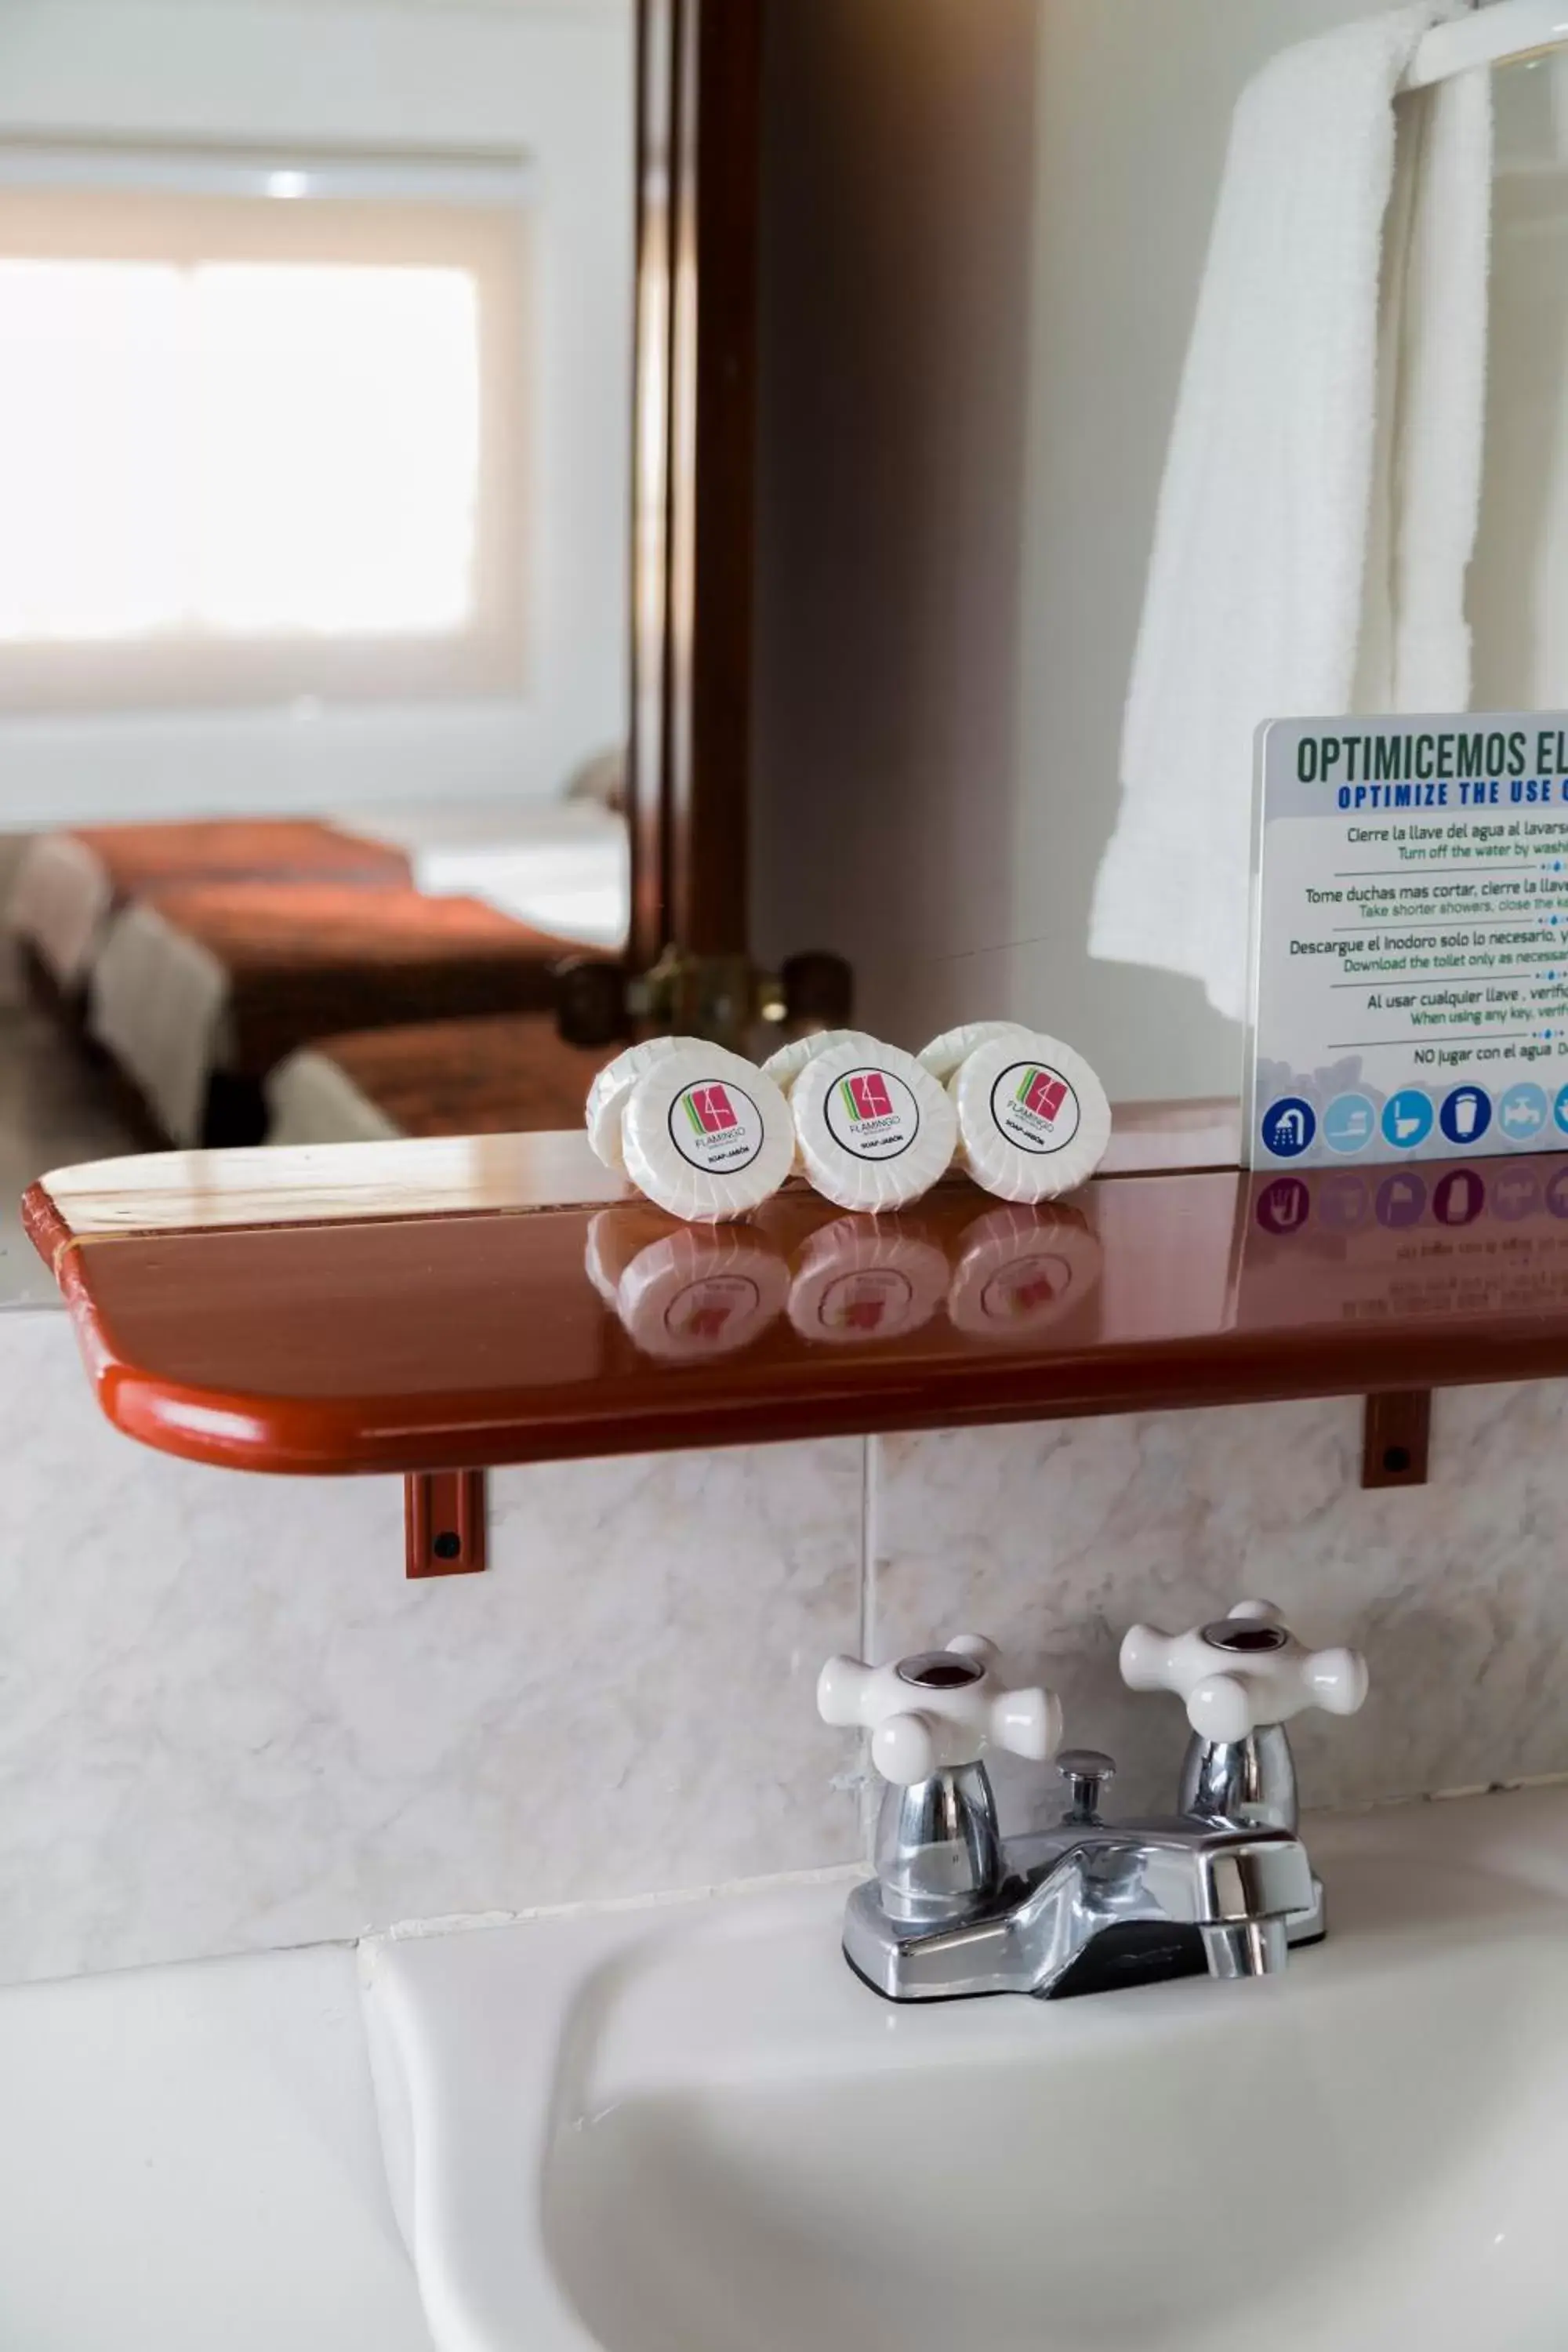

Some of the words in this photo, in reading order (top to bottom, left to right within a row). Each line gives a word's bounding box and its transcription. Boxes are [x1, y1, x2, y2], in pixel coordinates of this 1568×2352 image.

[1297, 731, 1526, 783] OPTIMICEMOS
[1536, 731, 1568, 776] EL
[1338, 783, 1448, 810] OPTIMIZE
[1460, 782, 1499, 804] THE
[1510, 779, 1551, 803] USE
[1347, 826, 1389, 843] Cierre
[1392, 825, 1406, 840] la
[1409, 824, 1443, 840] llave
[1447, 822, 1468, 838] del
[1472, 825, 1504, 842] agua
[1508, 820, 1520, 837] al
[1524, 821, 1568, 836] lavars
[1398, 846, 1426, 861] Turn
[1428, 844, 1448, 858] off
[1451, 844, 1472, 858] the
[1475, 844, 1512, 857] water
[1514, 843, 1529, 858] by
[1305, 887, 1342, 904] Tome
[1346, 885, 1396, 902] duchas
[1399, 887, 1429, 900] mas
[1481, 880, 1521, 895] cierre
[1524, 877, 1537, 893] la
[1359, 905, 1388, 918] Take
[1392, 902, 1436, 916] shorter
[1497, 898, 1531, 911] close
[1534, 898, 1554, 909] the
[1290, 938, 1364, 956] Descargue
[1367, 936, 1381, 951] el
[1384, 935, 1437, 950] inodoro
[1440, 931, 1468, 947] solo
[1472, 931, 1486, 946] lo
[1344, 957, 1406, 973] Download
[1410, 956, 1429, 970] the
[1432, 953, 1465, 968] toilet
[1468, 952, 1496, 967] only
[1498, 953, 1513, 964] as
[1367, 994, 1382, 1010] Al
[1385, 994, 1417, 1008] usar
[1420, 989, 1483, 1009] cualquier
[1411, 1011, 1446, 1025] When
[1449, 1009, 1482, 1025] using
[1485, 1010, 1508, 1025] any
[1414, 1048, 1436, 1063] NO
[1438, 1046, 1472, 1066] jugar
[1475, 1047, 1501, 1061] con
[1504, 1042, 1516, 1058] el
[1519, 1044, 1552, 1062] agua
[849, 1115, 901, 1134] FLAMINGO
[1006, 1099, 1054, 1133] FLAMINGO
[695, 1126, 746, 1149] FLAMINGO
